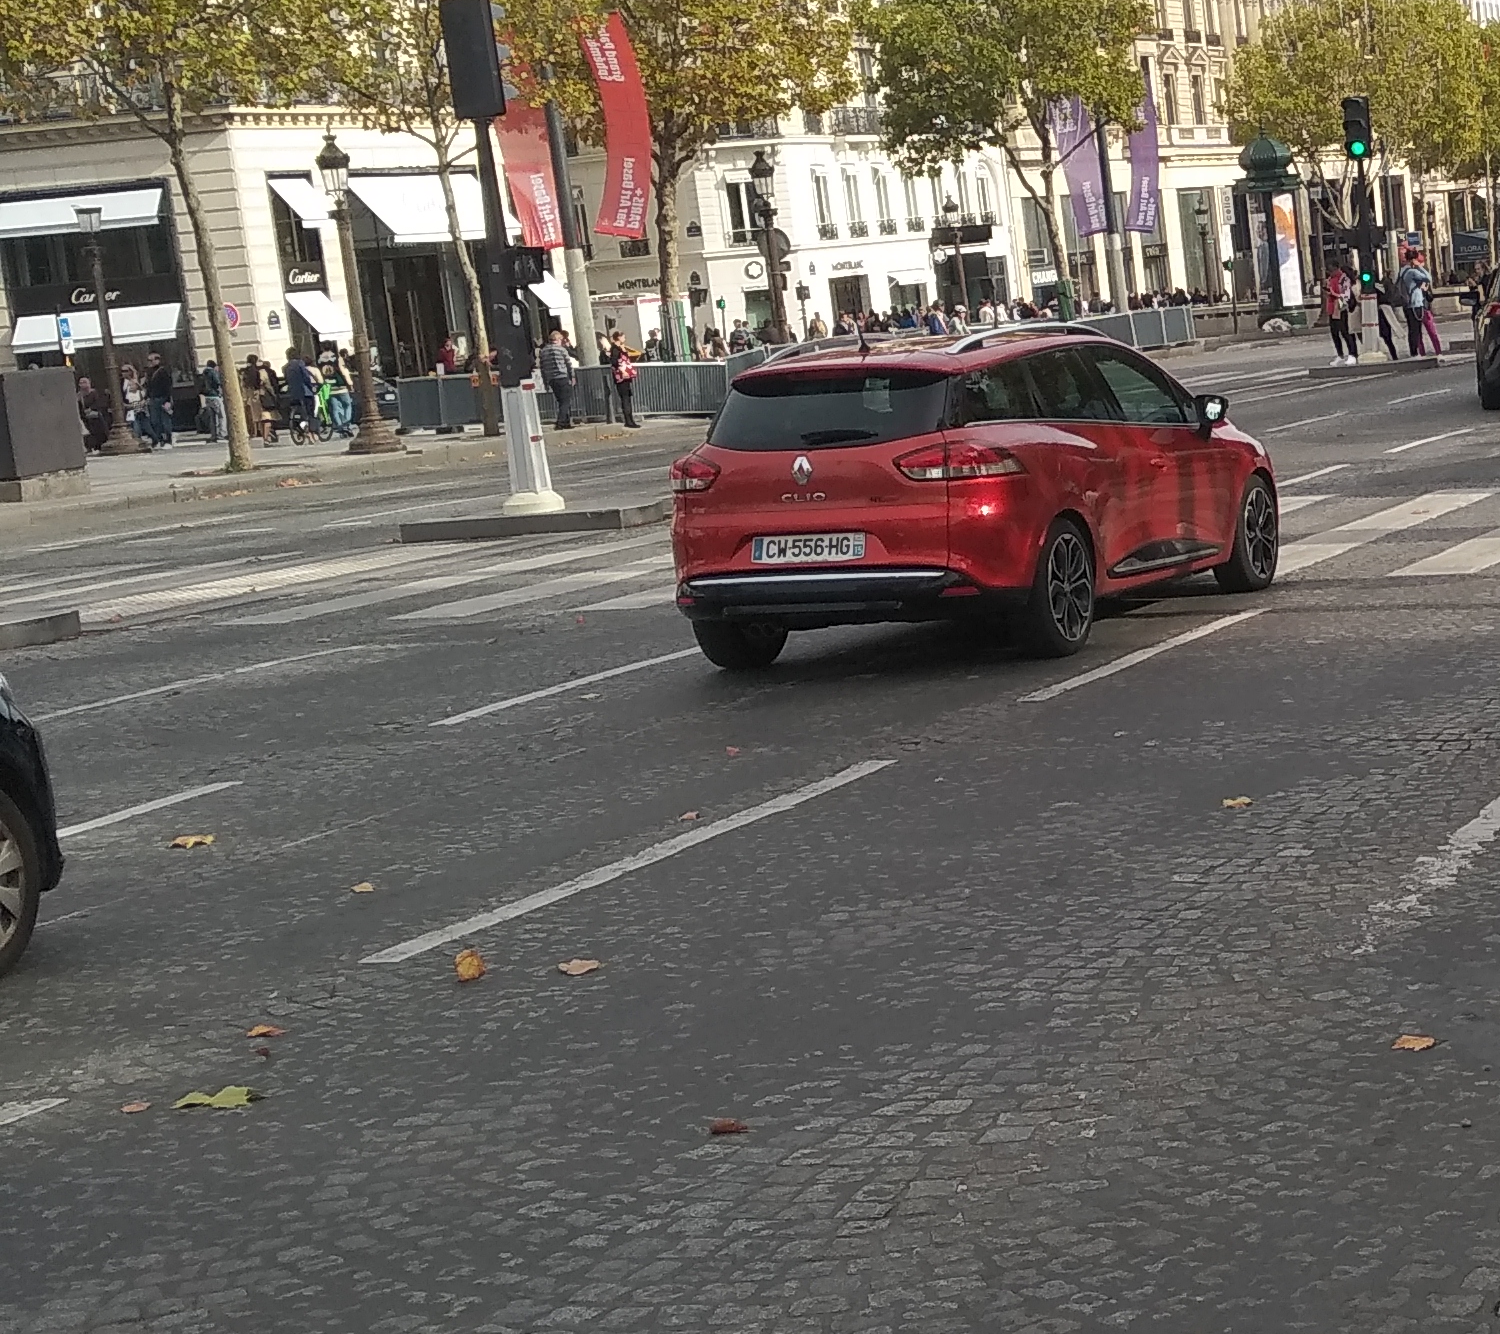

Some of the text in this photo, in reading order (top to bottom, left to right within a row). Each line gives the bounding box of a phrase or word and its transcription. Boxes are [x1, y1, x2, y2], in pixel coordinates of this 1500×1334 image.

[288, 269, 321, 286] Cartier
[617, 276, 661, 290] MONTBLAN
[71, 288, 120, 305] Carer
[781, 492, 826, 503] CLIO
